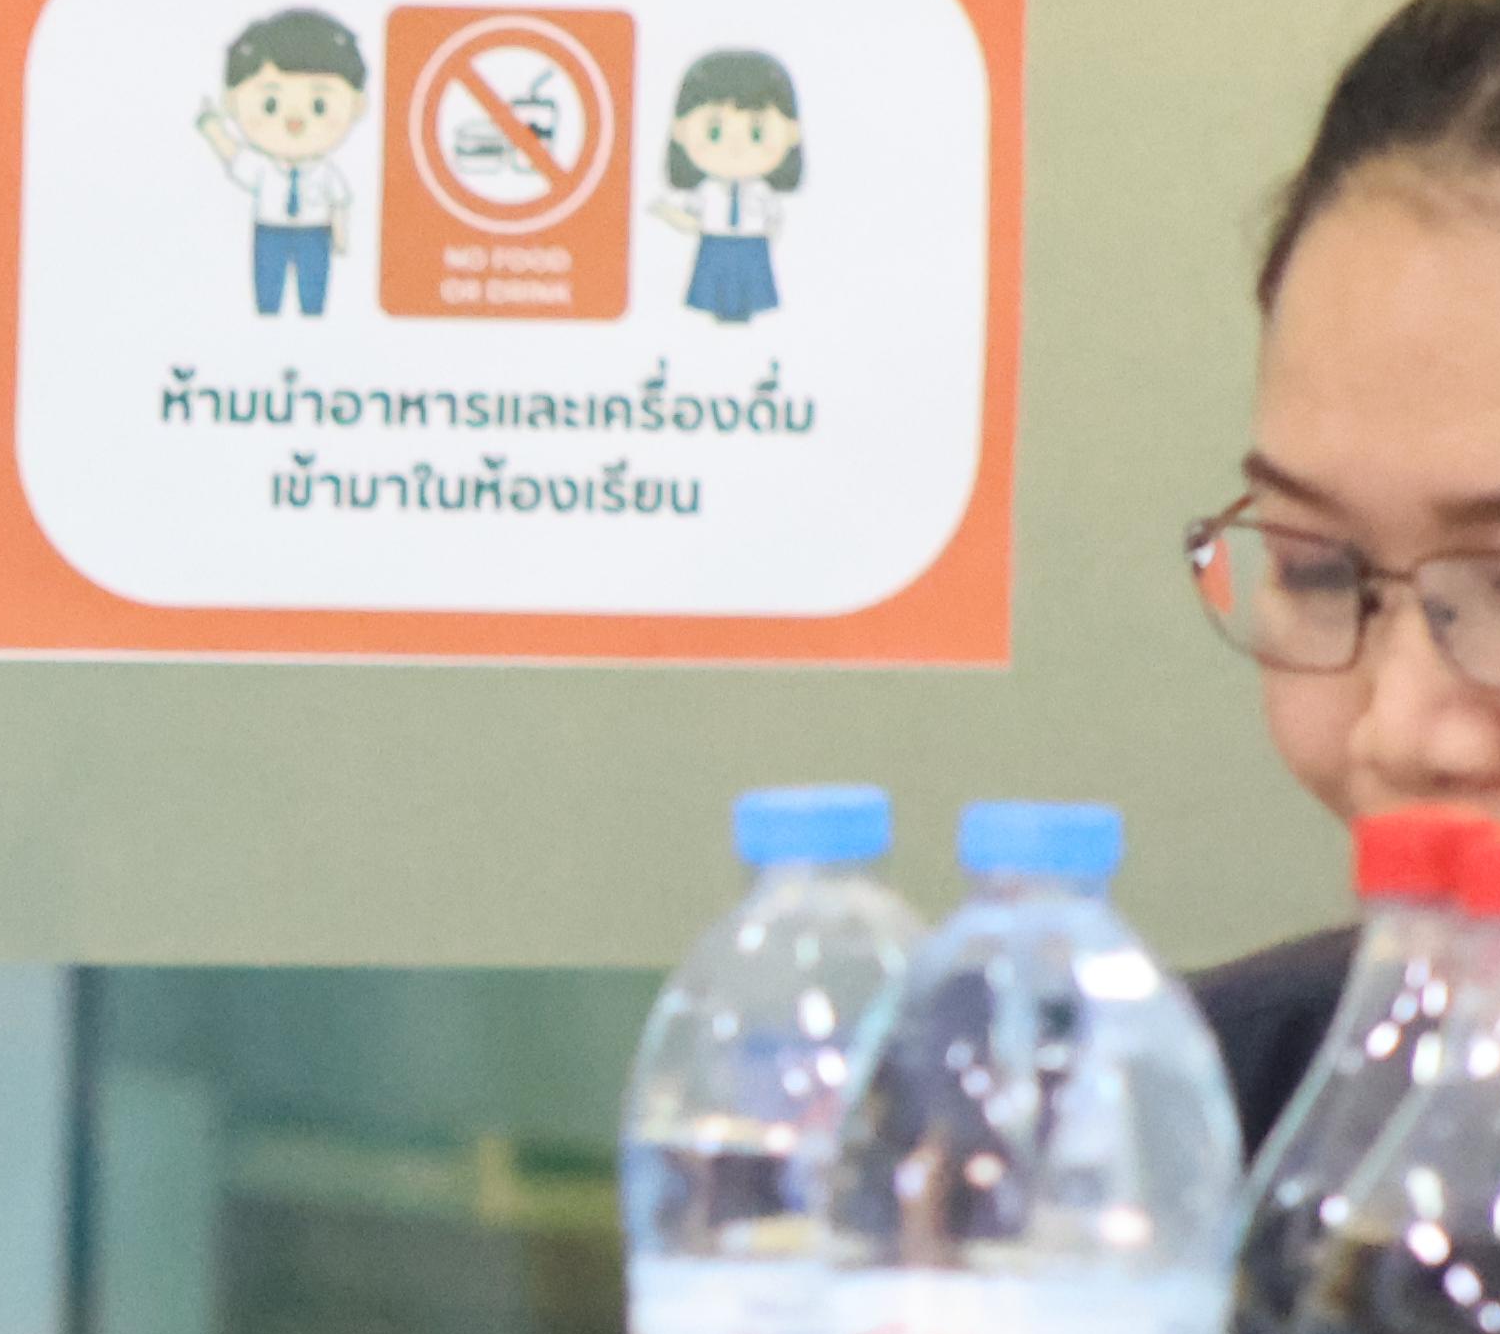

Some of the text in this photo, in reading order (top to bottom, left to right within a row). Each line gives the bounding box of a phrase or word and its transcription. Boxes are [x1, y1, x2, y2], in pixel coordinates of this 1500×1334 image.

[160, 358, 816, 435] ห้ามนำอาหารและเครื่องดื่ม
[271, 451, 702, 516] เข้ามาในห้องเรียน
